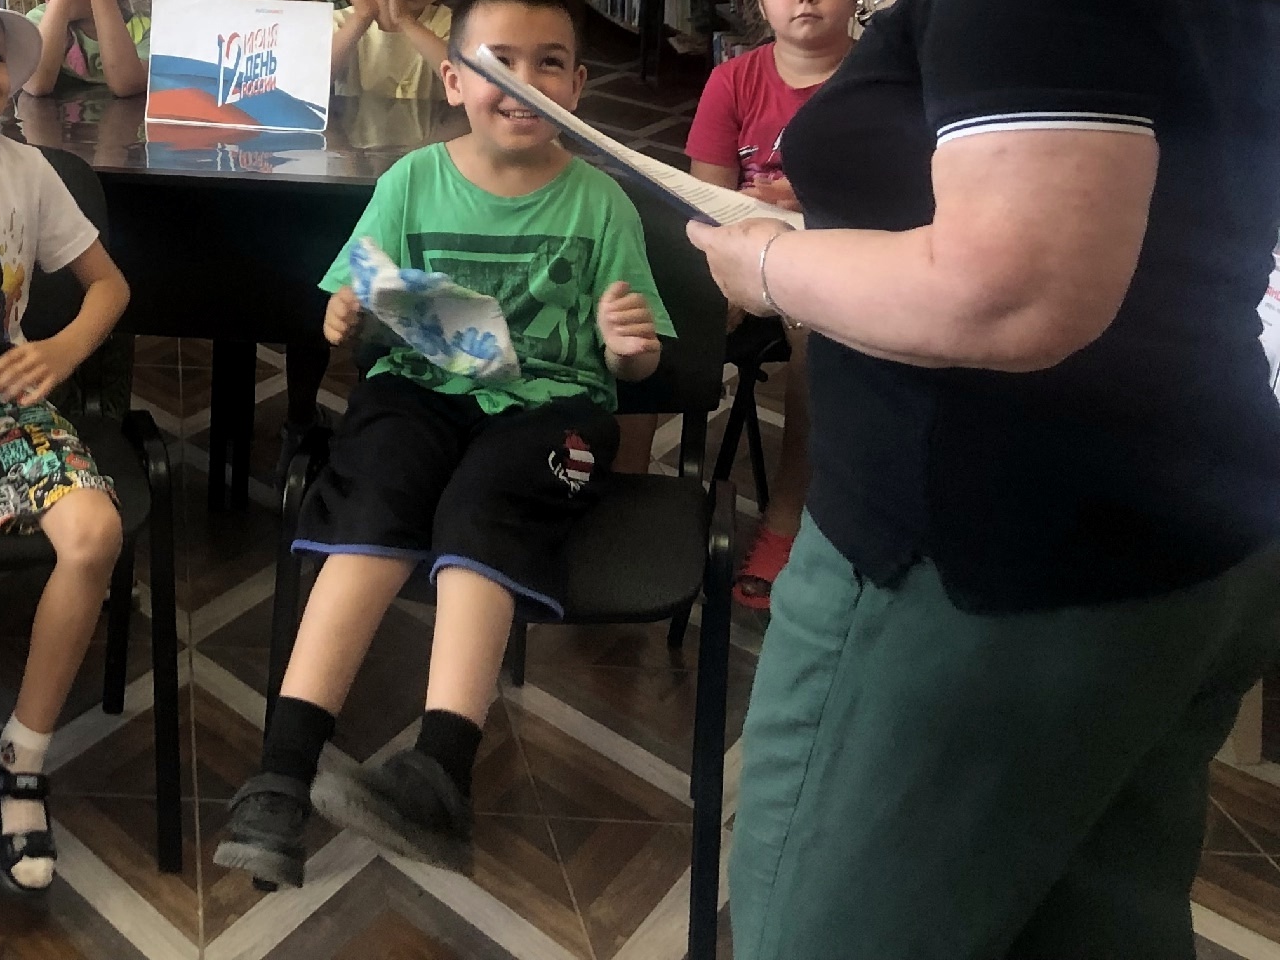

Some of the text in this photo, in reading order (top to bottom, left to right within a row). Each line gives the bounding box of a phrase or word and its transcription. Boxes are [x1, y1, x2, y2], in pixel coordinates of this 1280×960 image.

[217, 32, 242, 107] 12
[243, 50, 277, 81] ДЕНЬ
[241, 76, 276, 99] РОССИИ
